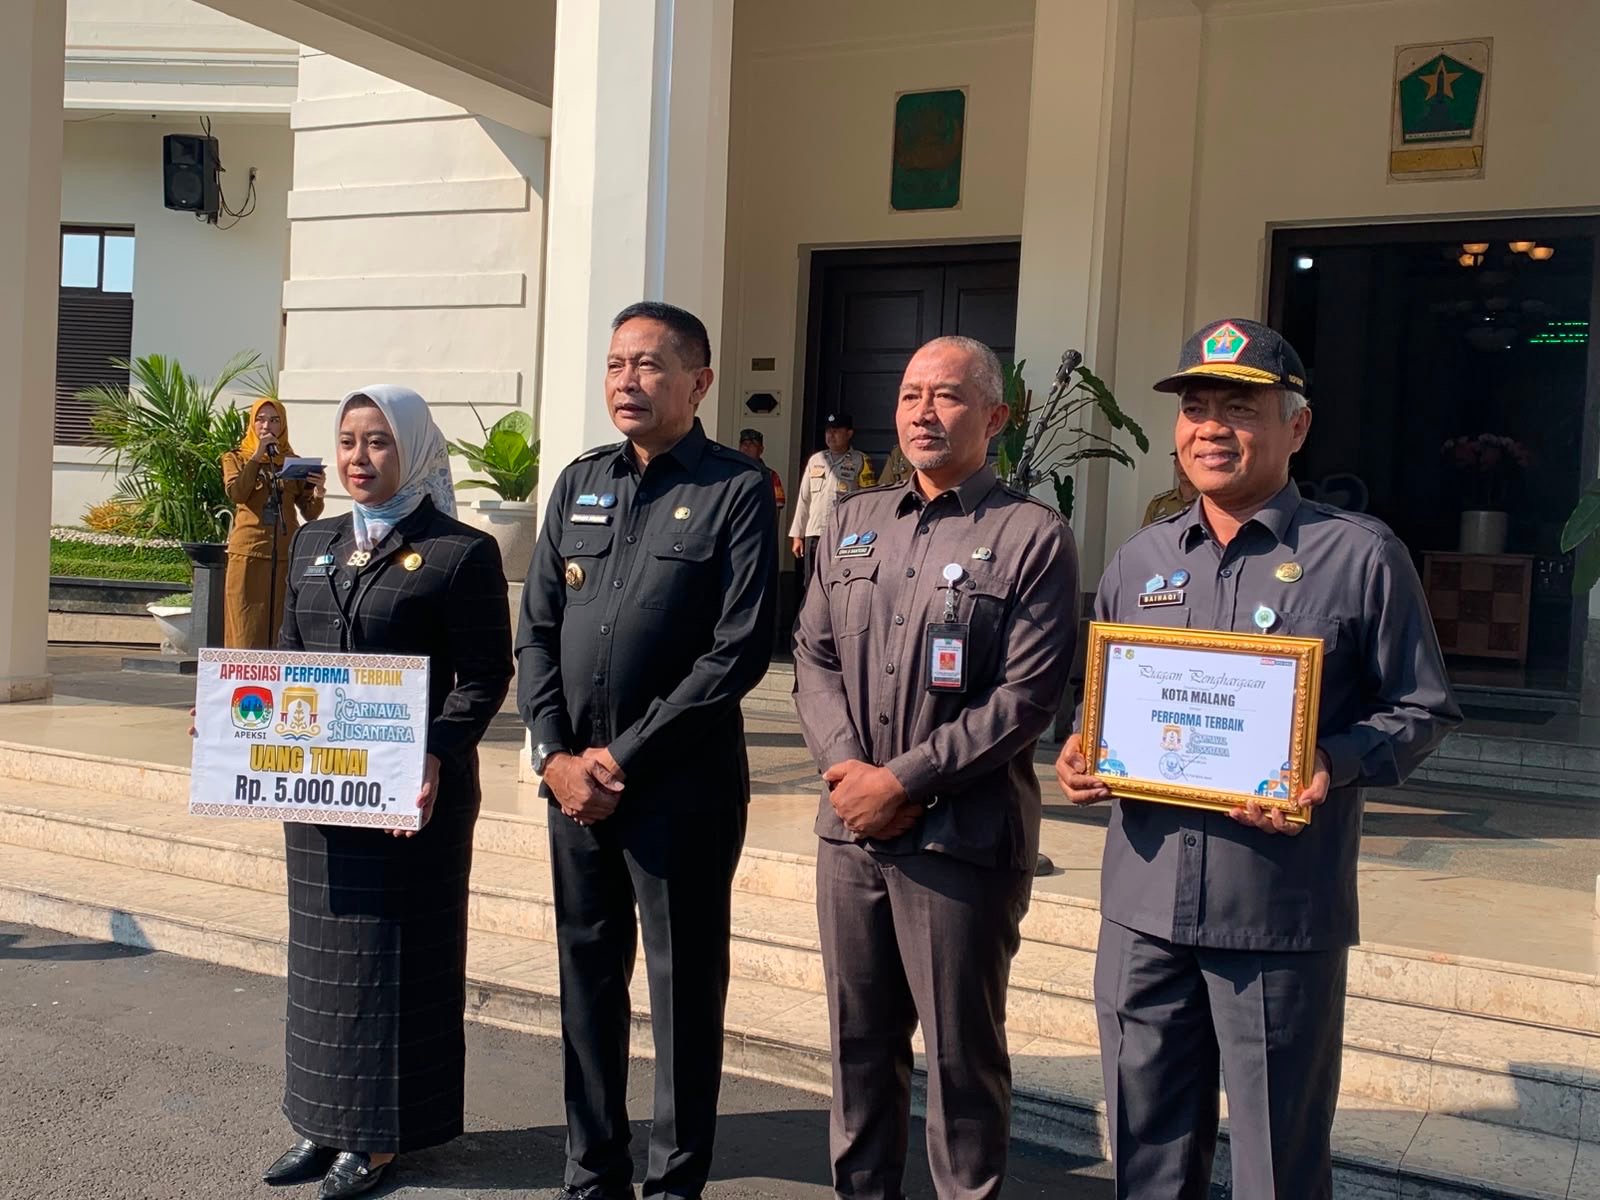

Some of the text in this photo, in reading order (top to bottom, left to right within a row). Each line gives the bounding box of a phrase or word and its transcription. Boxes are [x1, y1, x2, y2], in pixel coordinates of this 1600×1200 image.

[219, 663, 403, 686] APRESIASI PERFORMA TERBAIK
[1138, 664, 1266, 692] Piagam Penghargaan
[334, 687, 411, 722] CARNAVAL
[1161, 688, 1236, 707] KOTA MALANG
[327, 720, 415, 743] NUSANTARA
[1151, 709, 1245, 732] PERFORMA TERBAIK
[234, 731, 267, 740] APEKSI
[250, 744, 369, 777] UANG TUNAI
[235, 775, 397, 811] Rp. 5.000.000,-
